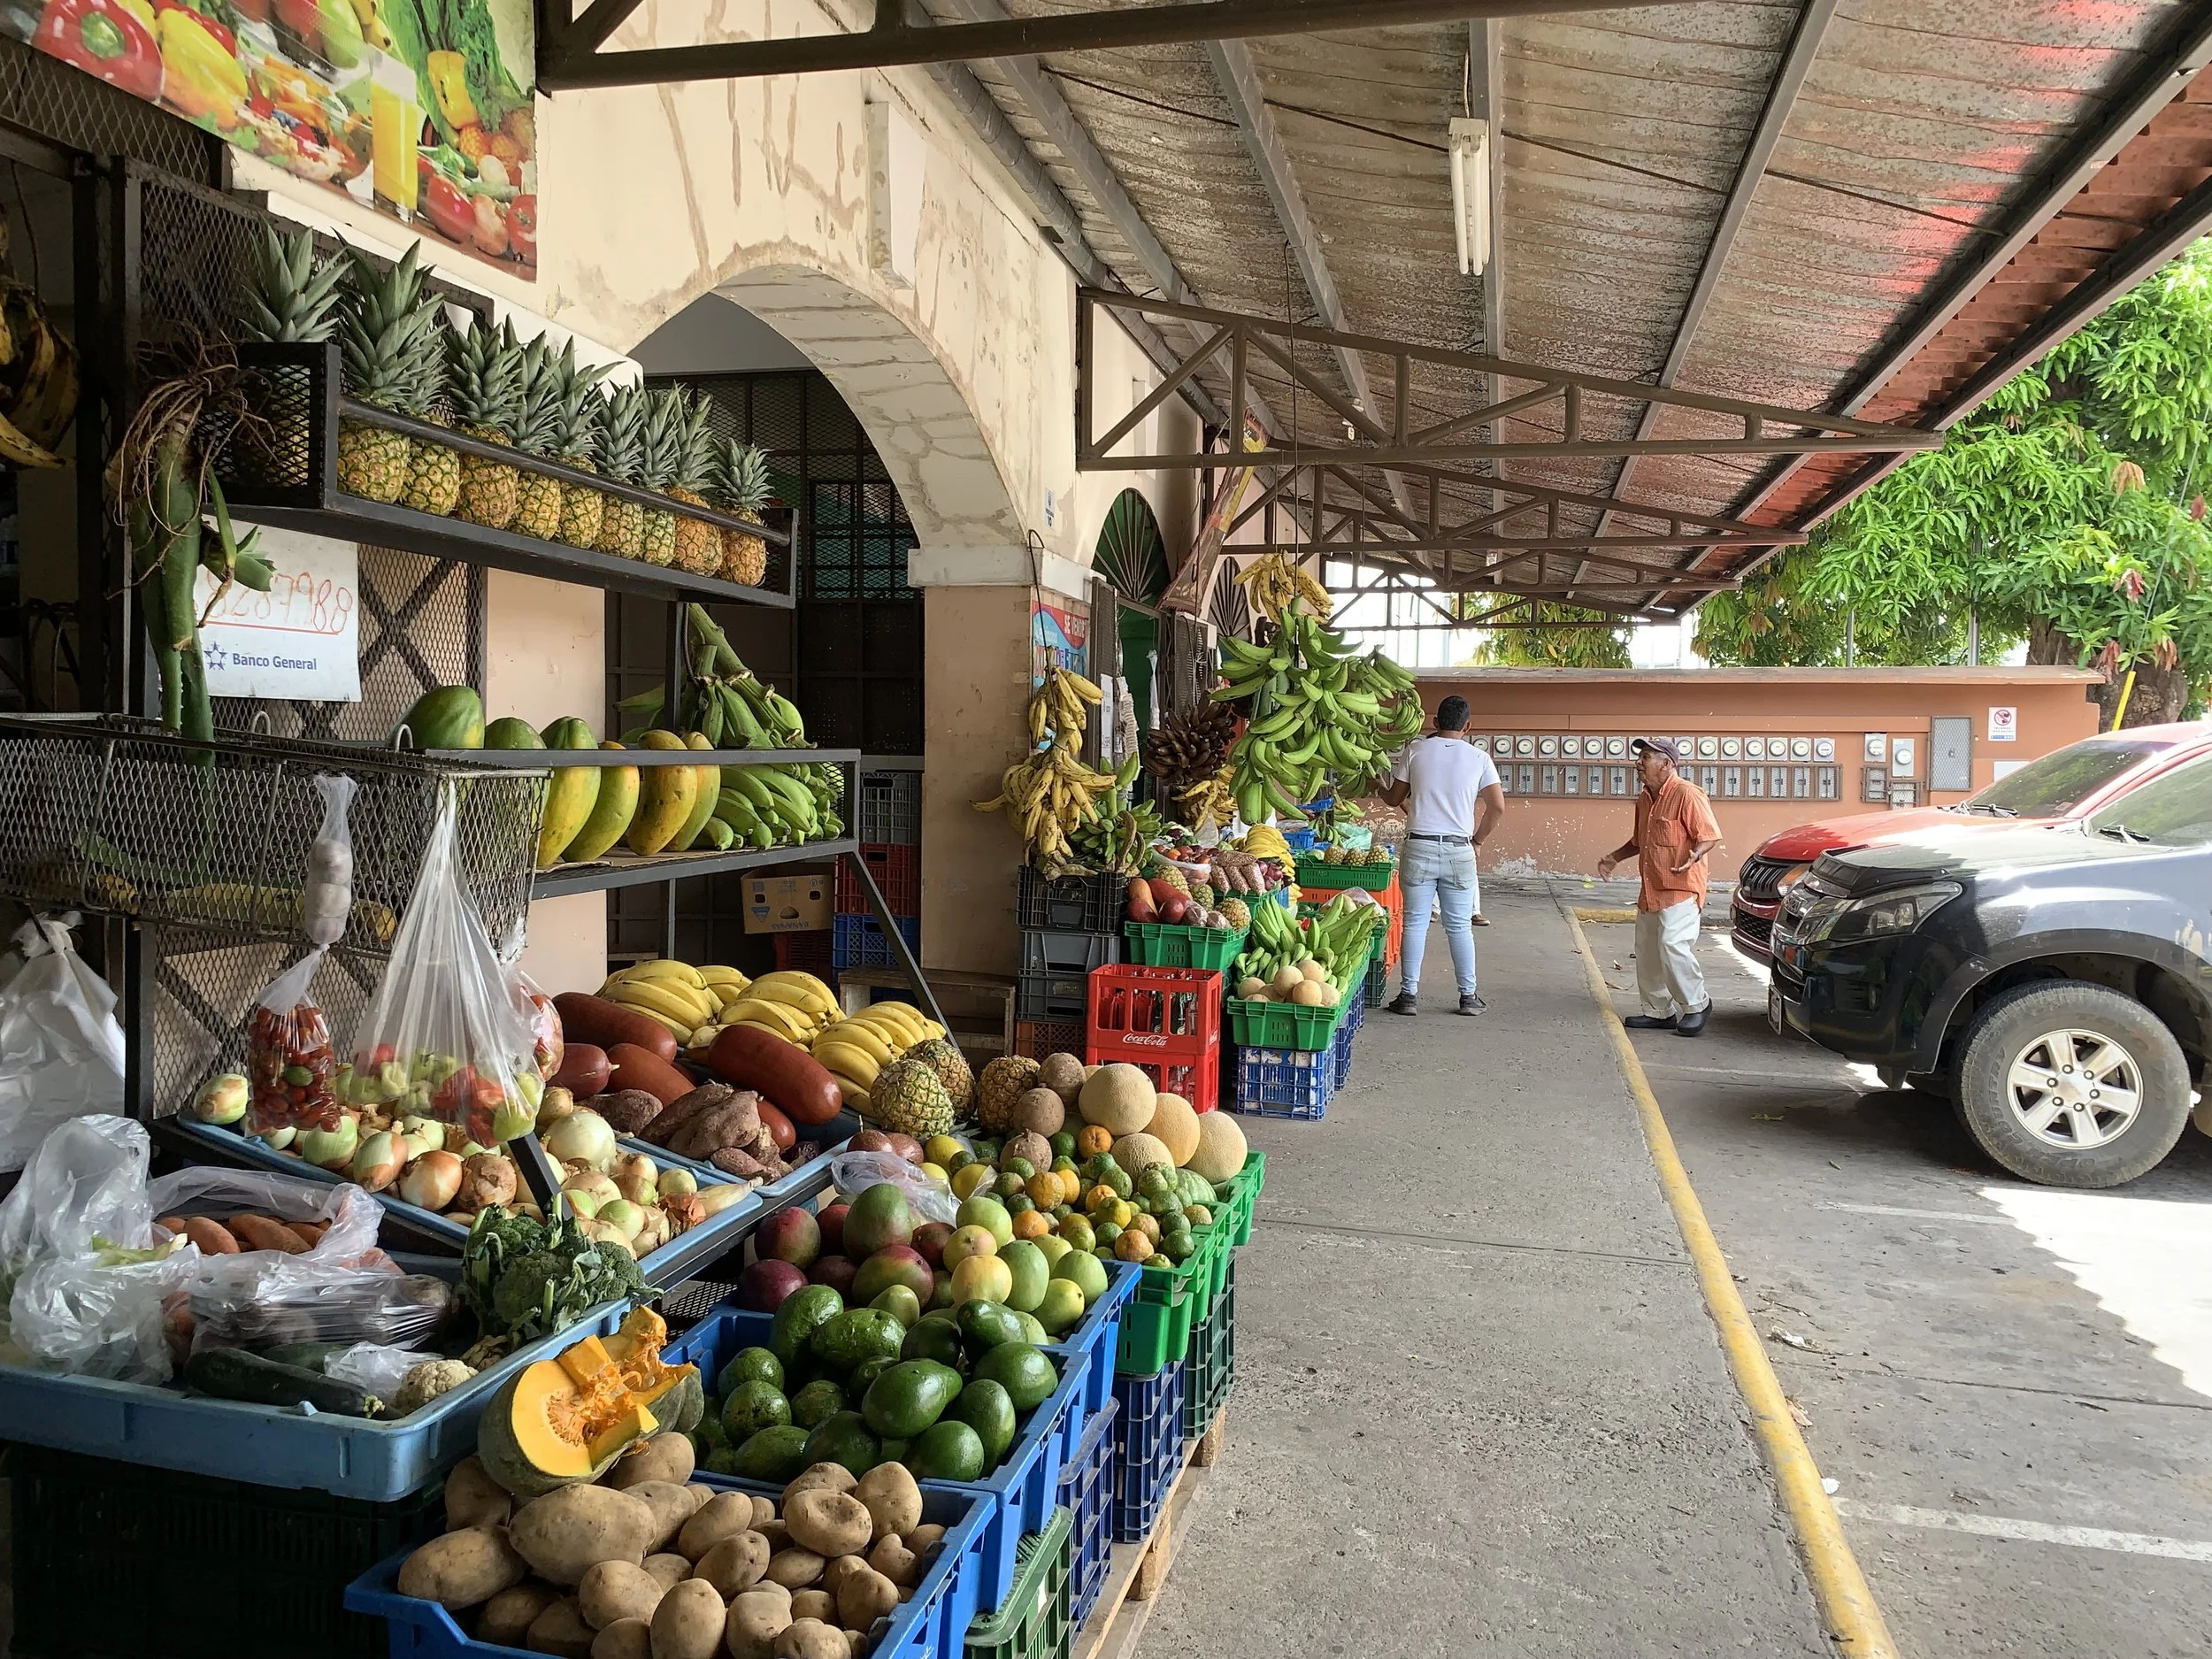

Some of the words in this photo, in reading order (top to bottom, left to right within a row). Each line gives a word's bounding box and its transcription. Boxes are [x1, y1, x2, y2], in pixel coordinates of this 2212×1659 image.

[233, 652, 270, 667] Banco
[273, 655, 317, 671] General
[1122, 1033, 1169, 1046] Coca-Cola
[1988, 1046, 2024, 1146] COUNTRY
